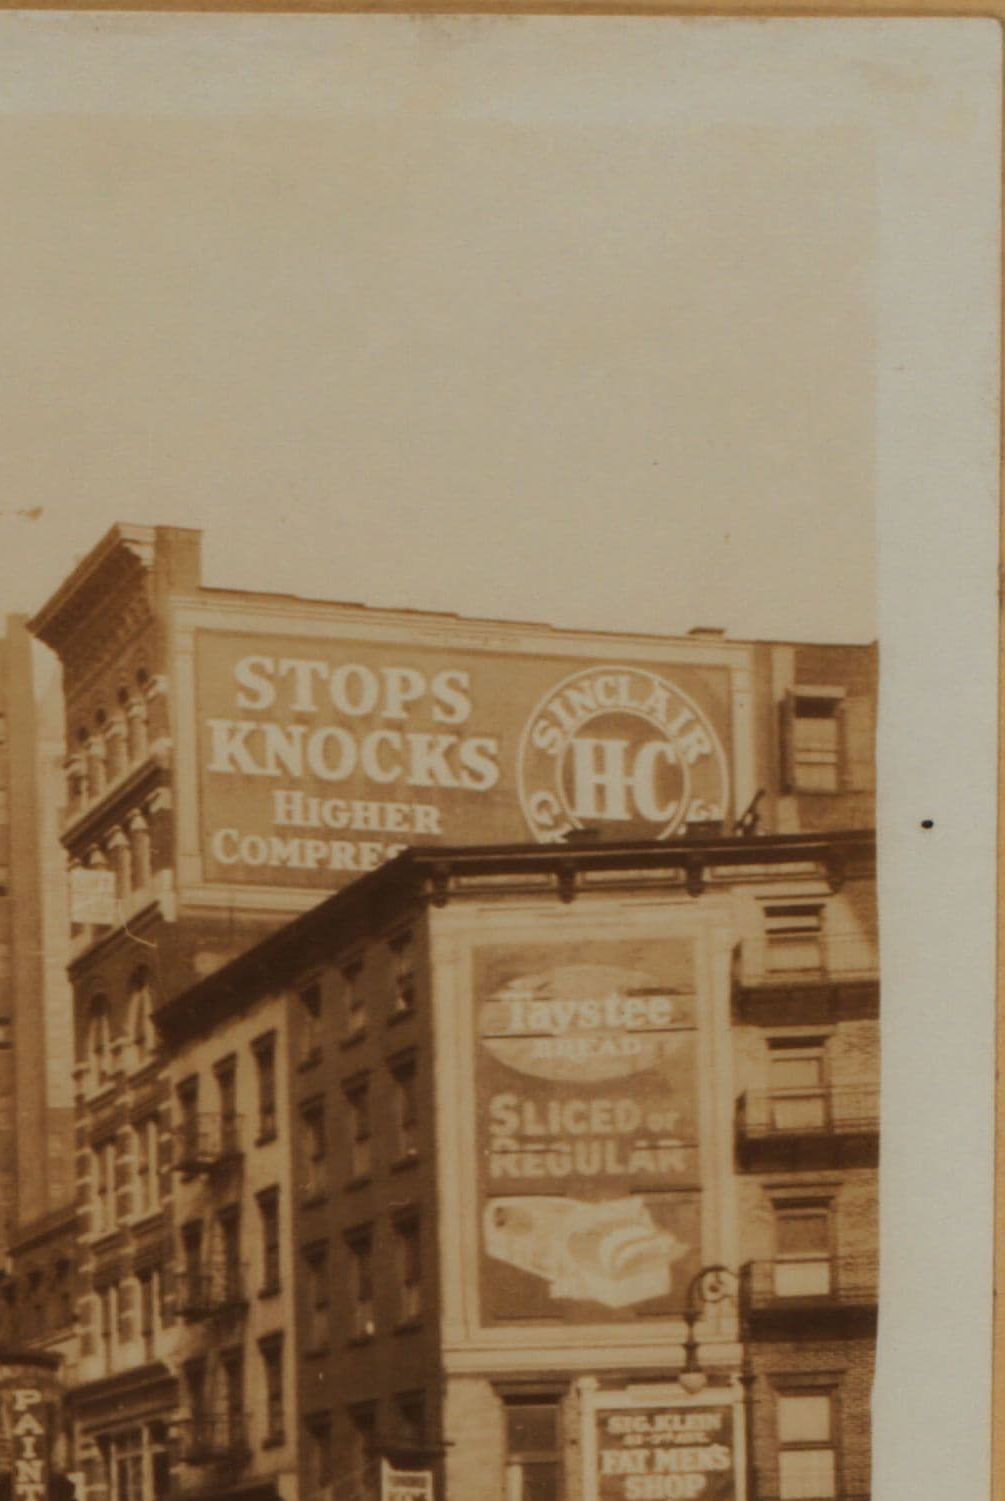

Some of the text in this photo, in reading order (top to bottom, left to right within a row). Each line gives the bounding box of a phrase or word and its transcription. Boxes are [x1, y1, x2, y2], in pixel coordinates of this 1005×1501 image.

[233, 655, 472, 725] STOPS
[532, 674, 711, 765] SINCLAIR
[206, 718, 501, 791] KNOCKS
[273, 789, 443, 834] HIGHER
[504, 991, 674, 1037] Taystee
[532, 1037, 642, 1059] BREAD
[489, 1093, 682, 1135] SLICED or
[489, 1136, 686, 1178] REGULAR
[599, 1448, 651, 1474] FAT
[625, 1473, 707, 1501] SHOP
